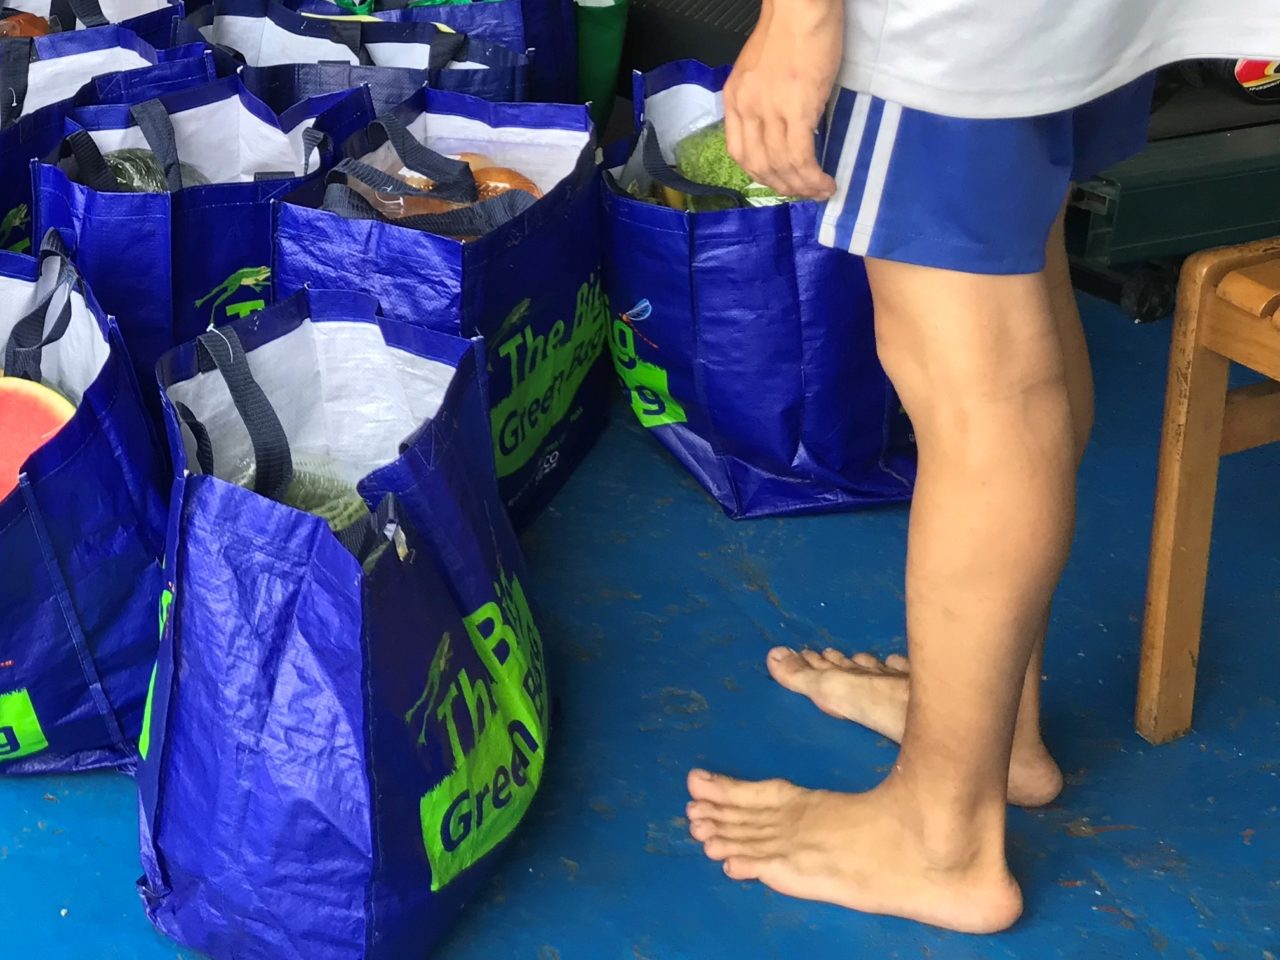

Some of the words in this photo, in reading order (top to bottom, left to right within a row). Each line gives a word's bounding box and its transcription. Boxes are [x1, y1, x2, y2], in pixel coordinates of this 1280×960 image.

[498, 318, 566, 392] The
[498, 369, 566, 458] Green
[437, 667, 498, 768] Th
